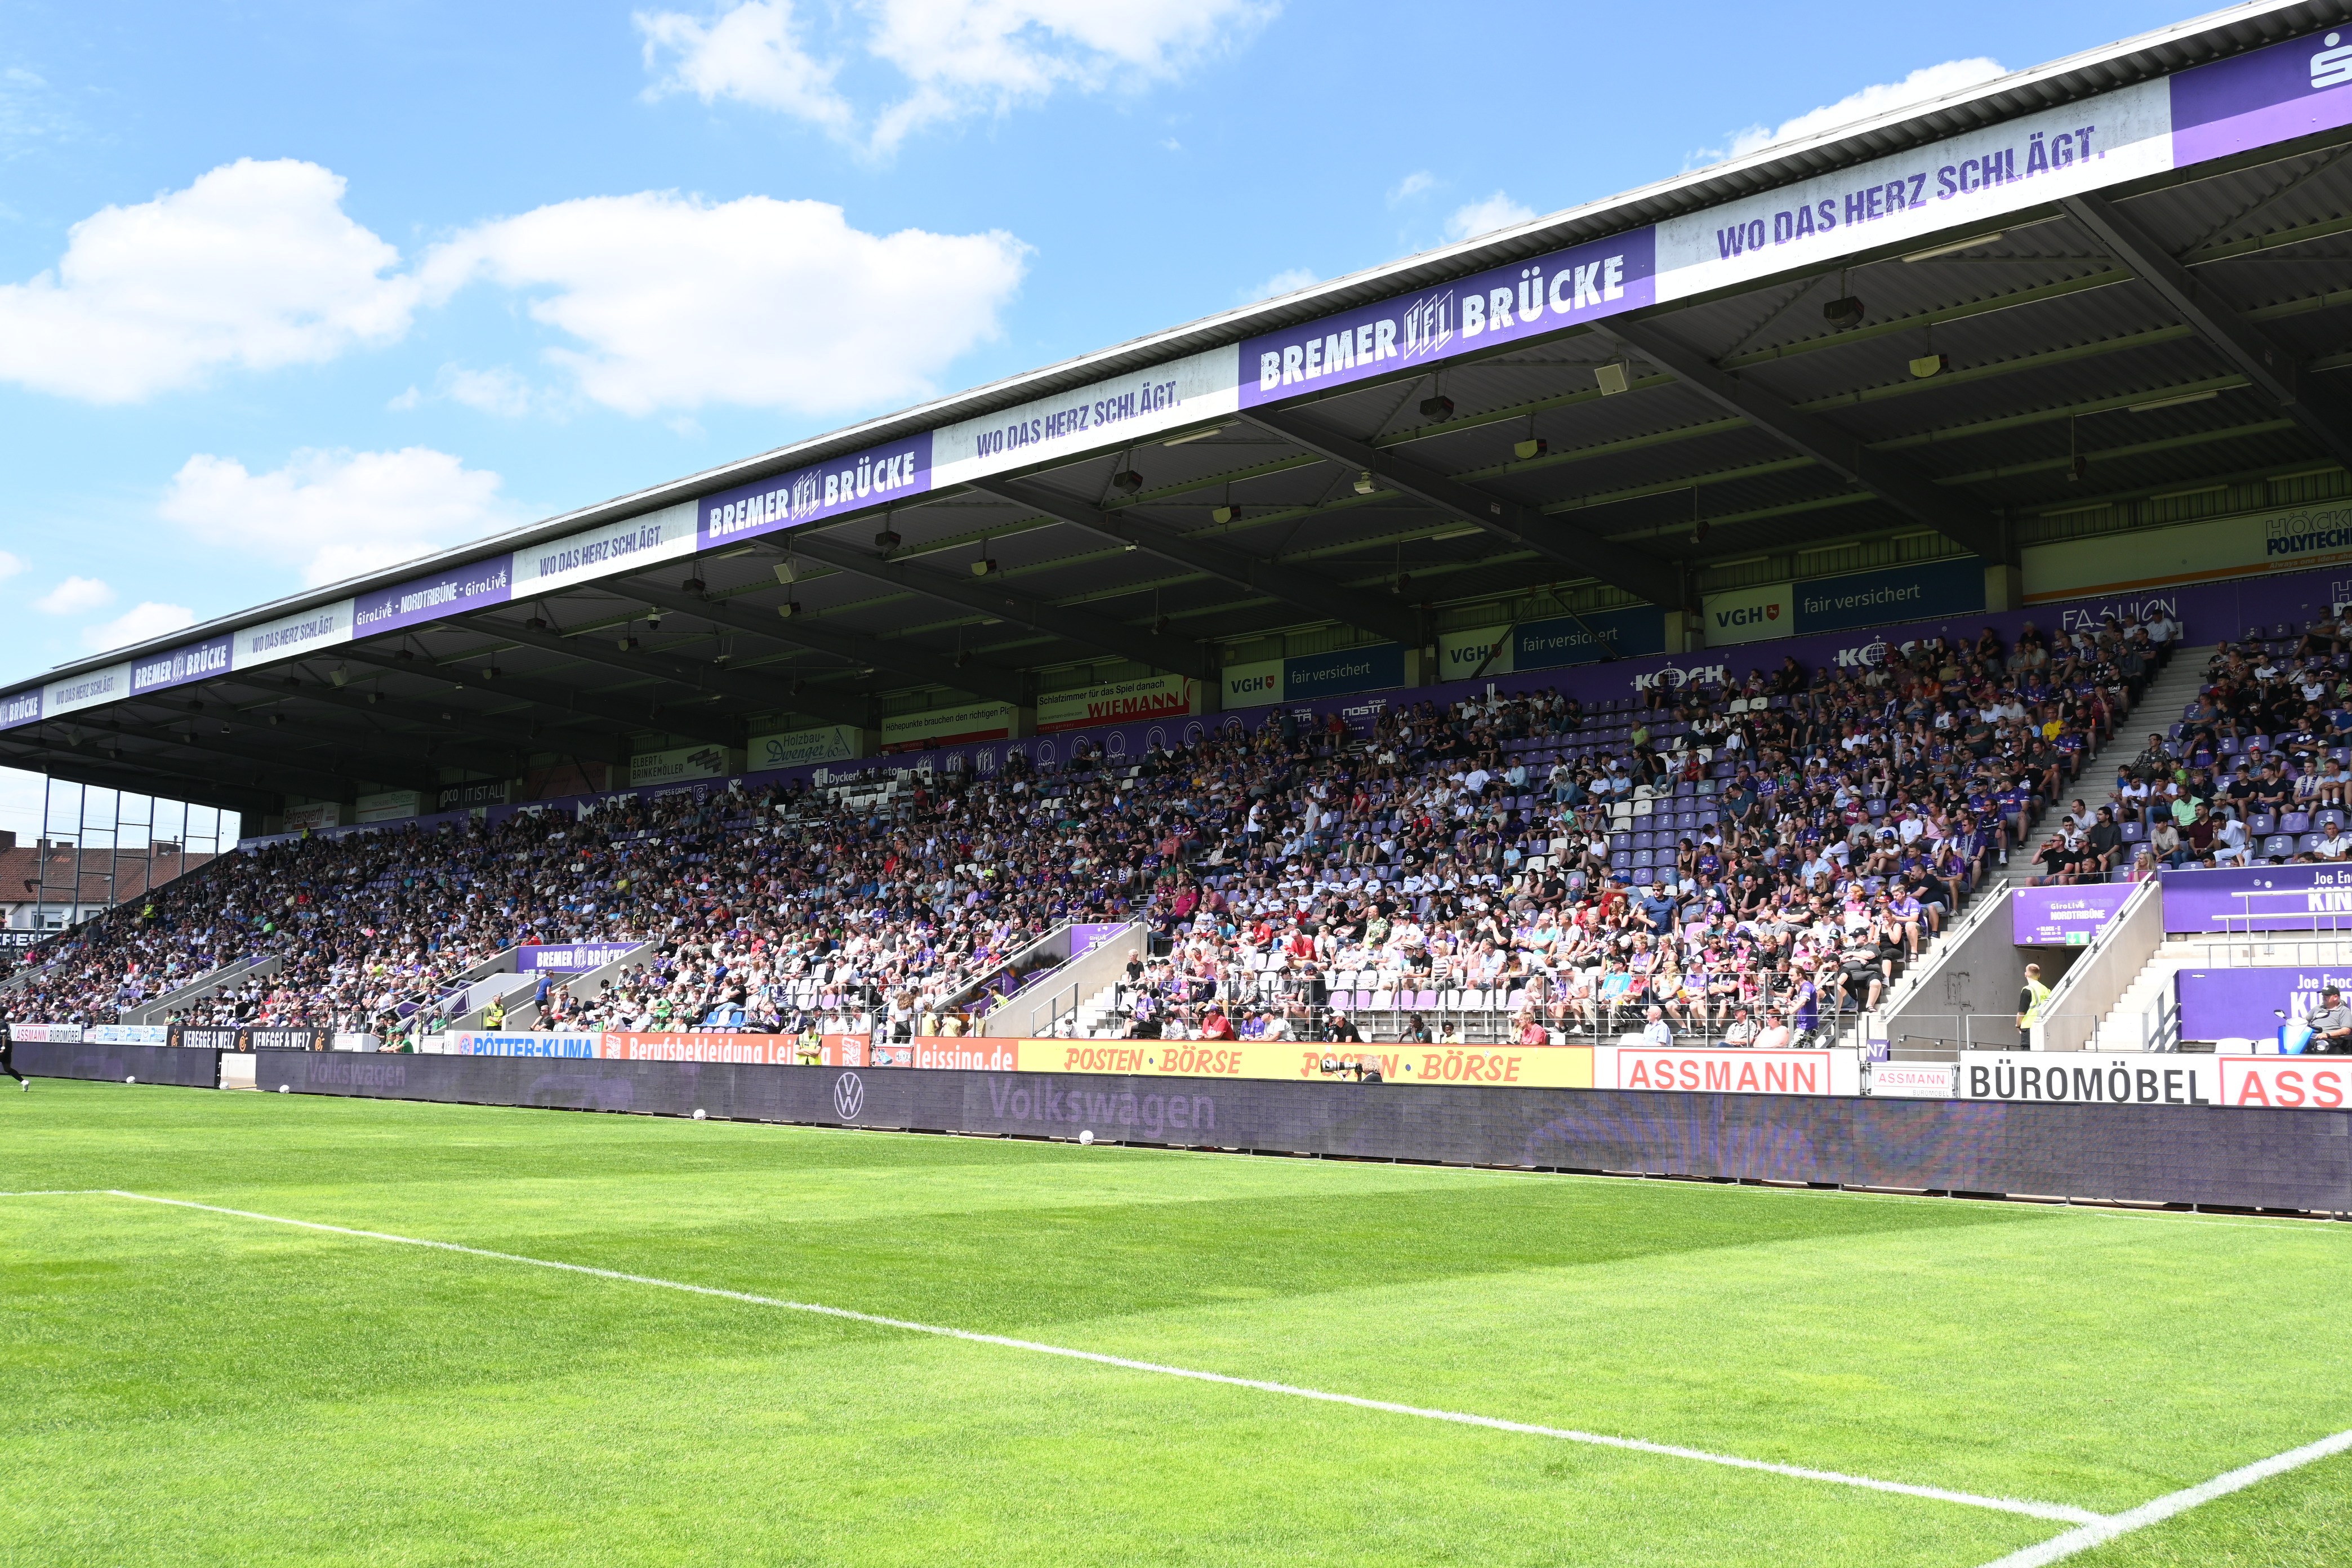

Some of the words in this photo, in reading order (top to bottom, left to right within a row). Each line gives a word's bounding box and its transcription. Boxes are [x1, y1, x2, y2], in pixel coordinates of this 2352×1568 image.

[1717, 219, 1765, 261] WO
[1774, 199, 1836, 246] DAS
[1845, 172, 1927, 228] HERZ
[1936, 125, 2106, 202] SCHLÄGT.
[1260, 318, 1398, 393] BREMER
[1404, 289, 1453, 360] VFL
[1462, 254, 1624, 339] BRÜCKE
[977, 433, 1003, 459] WO
[1007, 419, 1041, 451] DAS
[1045, 405, 1089, 441] HERZ
[1094, 381, 1181, 427] SCHLÄGT.
[709, 488, 789, 539] BREMER
[791, 469, 821, 521] VFL
[823, 451, 915, 507] BRÜCKE
[2266, 510, 2352, 538] HÖCK
[539, 557, 556, 578] WO
[558, 550, 580, 573] DAS
[582, 539, 609, 567] HERZ
[612, 525, 663, 558] SCHLÄGT.
[2267, 528, 2352, 555] POLYTECH
[2269, 559, 2298, 569] Always
[2318, 553, 2336, 562] idea
[357, 603, 393, 626] GiroLive
[400, 581, 458, 614] NORDTRIBÜNE
[465, 573, 506, 596] GiroLive
[1805, 597, 1831, 614] fair
[1835, 583, 1921, 609] versichert
[1717, 606, 1762, 627] VGH
[253, 637, 264, 654] WO
[265, 632, 279, 652] DAS
[281, 627, 299, 646] HERZ
[300, 616, 334, 642] SCHLÄGT.
[1523, 636, 1544, 653] fair
[135, 660, 171, 689] BREMER
[186, 644, 226, 676] BRÜCKE
[1450, 645, 1489, 663] VGH
[1231, 677, 1263, 693] VGH
[1291, 670, 1311, 684] fair
[1312, 661, 1370, 680] versichert
[56, 691, 65, 705] WO
[65, 687, 75, 703] DAS
[75, 683, 89, 700] HERZ
[90, 676, 114, 697] SCHLÄGT.
[1039, 692, 1087, 705] Schlafzimmer
[1089, 689, 1099, 697] für
[1101, 687, 1113, 696] das
[1116, 683, 1134, 695] Spiel
[1137, 679, 1164, 692] danach
[9, 696, 38, 722] BRÜCKE
[1087, 692, 1178, 719] WIEMANN
[886, 719, 923, 732] Höhepunkte
[924, 715, 954, 727] brauchen
[955, 712, 968, 721] den
[969, 708, 998, 721] richtigen
[766, 740, 824, 764] Dwenger
[783, 733, 825, 747] Holzbau-
[632, 764, 683, 779] BRINKEMÖLLER
[633, 755, 657, 768] ELBERT
[658, 755, 662, 764] &
[975, 746, 996, 776] VFL
[829, 767, 875, 785] Dyckerhff
[881, 767, 903, 777] eton
[474, 785, 487, 800] IST
[283, 804, 324, 830] Behrenswerth
[2314, 872, 2333, 885] Joe
[2338, 870, 2352, 884] En
[2050, 908, 2105, 920] NORDTRIBÜNE
[2051, 901, 2084, 910] GiroLive
[537, 951, 572, 968] BREMER
[2297, 974, 2319, 989] Joe
[2323, 974, 2352, 989] Enoc
[16, 1029, 46, 1041] ASSMANN
[50, 1027, 81, 1043] BÜROMÖBEL
[184, 1030, 211, 1048] VEREGGE
[212, 1031, 217, 1048] &
[218, 1031, 235, 1049] WELZ
[284, 1032, 291, 1048] &
[474, 1032, 593, 1058] PÖTTER-KLIMA
[874, 1032, 883, 1041] N6
[629, 1037, 763, 1064] Berufsbekleidung
[916, 1045, 1013, 1072] leissing.de
[1064, 1048, 1144, 1071] POSTEN
[1159, 1045, 1243, 1074] BÖRSE
[1867, 1044, 1886, 1057] N7
[308, 1054, 406, 1088] Volkswagen
[1300, 1052, 1400, 1078] POSTN
[1418, 1049, 1522, 1082] BÖRSE
[1629, 1059, 1816, 1092] ASSMANN
[1879, 1073, 1944, 1085] ASSMANN
[1971, 1059, 2209, 1104] BÜROMÖBEL
[2237, 1070, 2352, 1107] ASS
[988, 1076, 1214, 1138] Volkswagen
